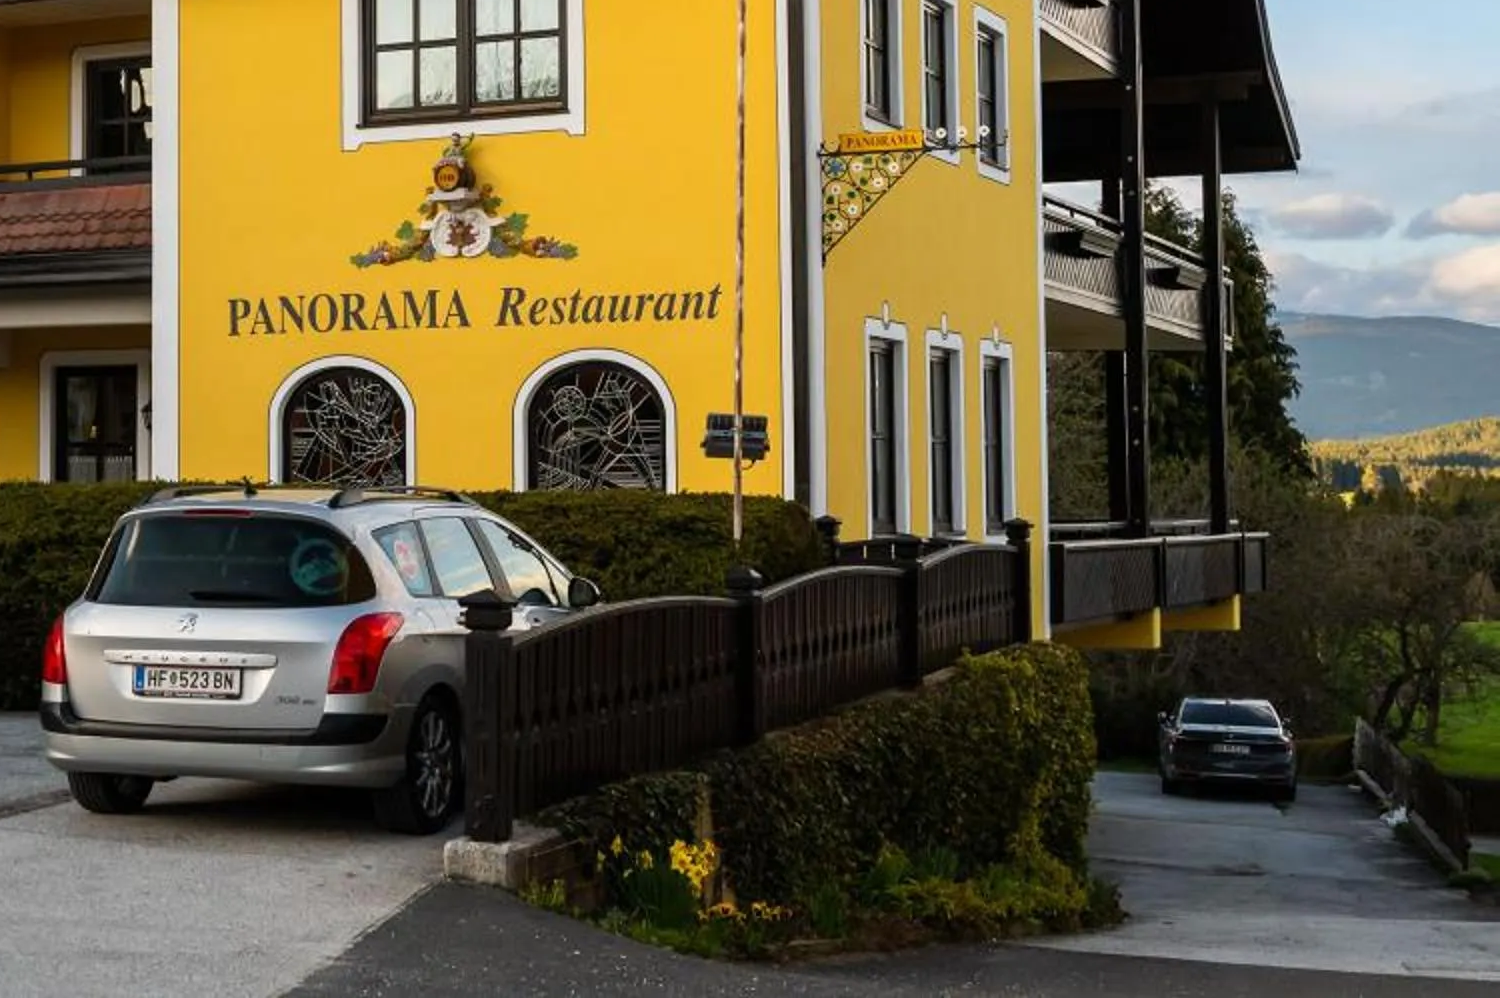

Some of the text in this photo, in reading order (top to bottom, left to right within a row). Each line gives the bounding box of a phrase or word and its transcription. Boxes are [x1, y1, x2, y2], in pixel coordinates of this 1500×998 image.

[847, 133, 918, 149] PANORAMA
[227, 281, 723, 337] PANORAMA Restaurant
[147, 669, 234, 691] HF 523 BN
